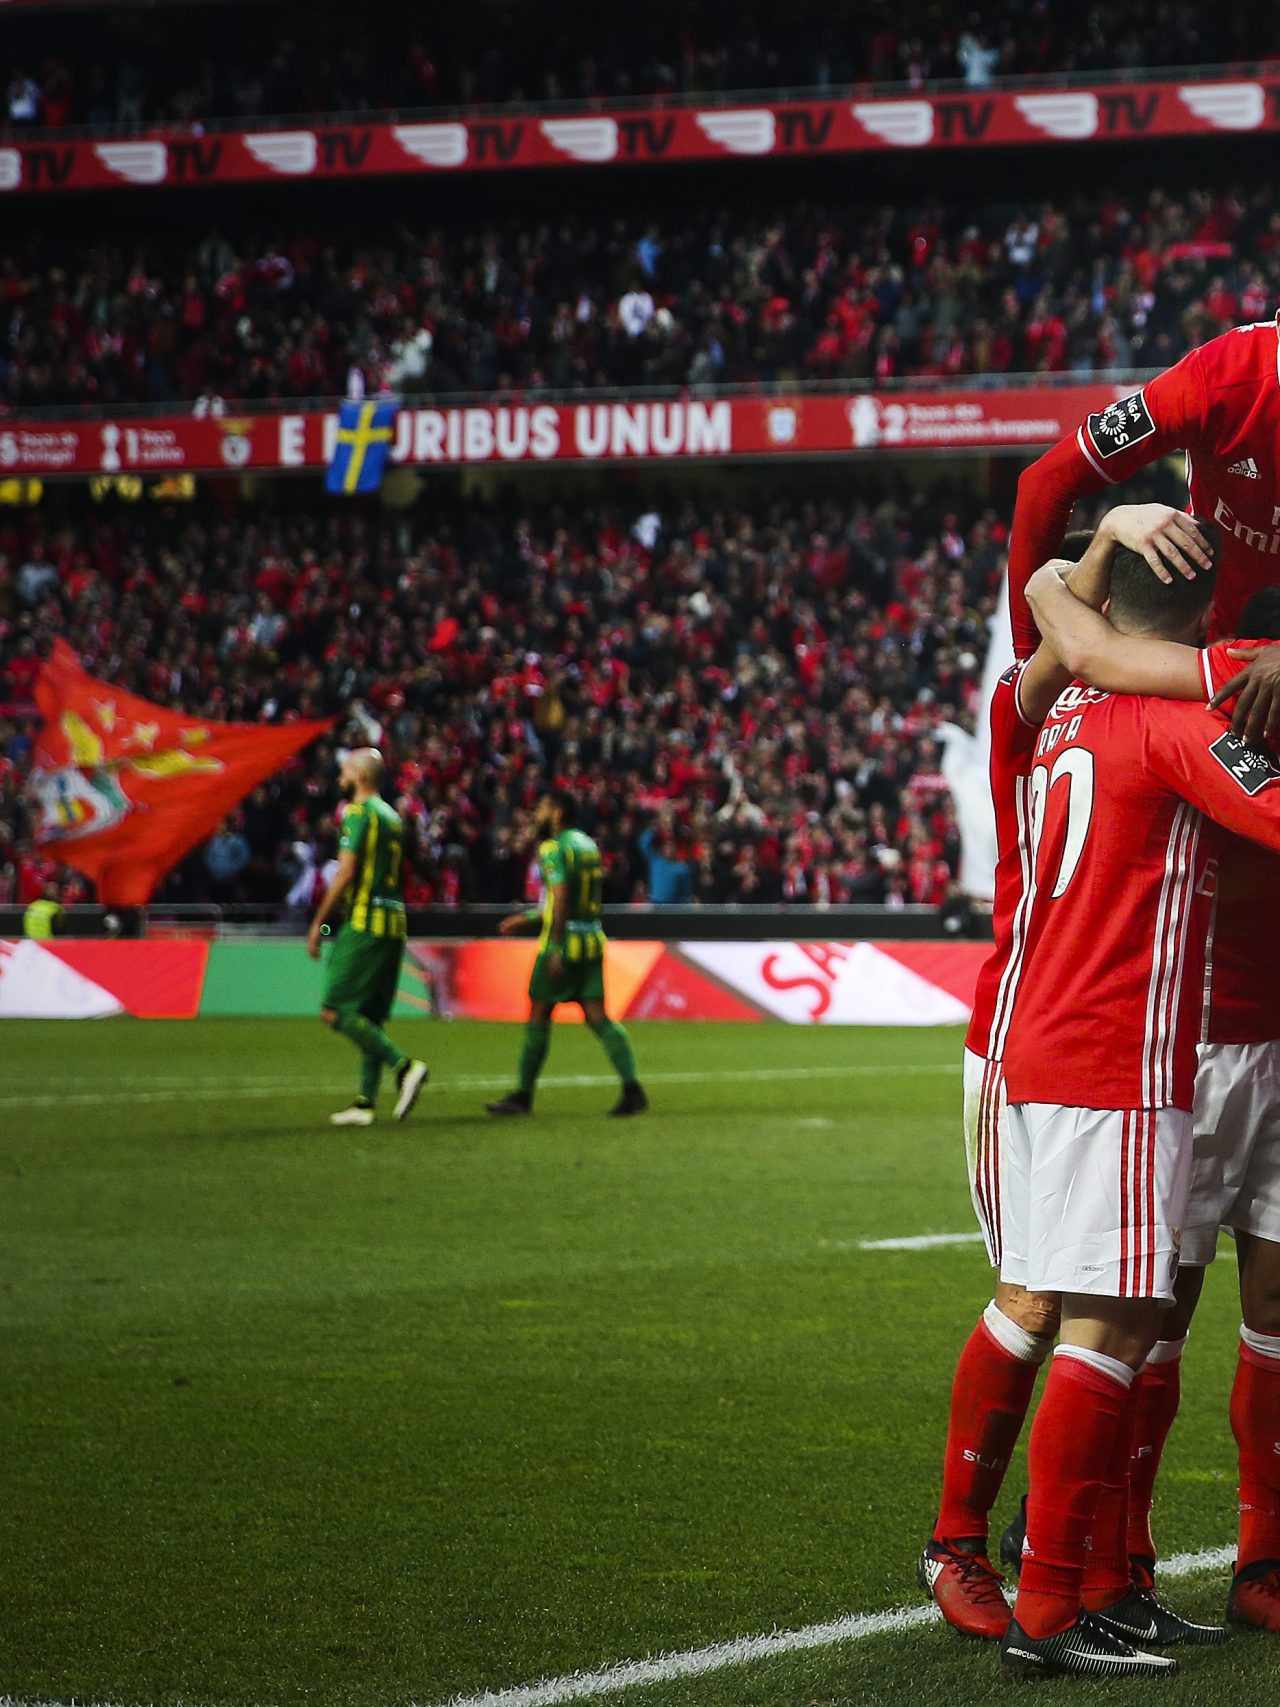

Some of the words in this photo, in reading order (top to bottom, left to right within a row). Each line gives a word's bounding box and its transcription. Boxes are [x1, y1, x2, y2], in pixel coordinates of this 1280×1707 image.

[279, 415, 306, 465] E
[575, 400, 732, 456] UNUM
[1227, 466, 1262, 480] adidas
